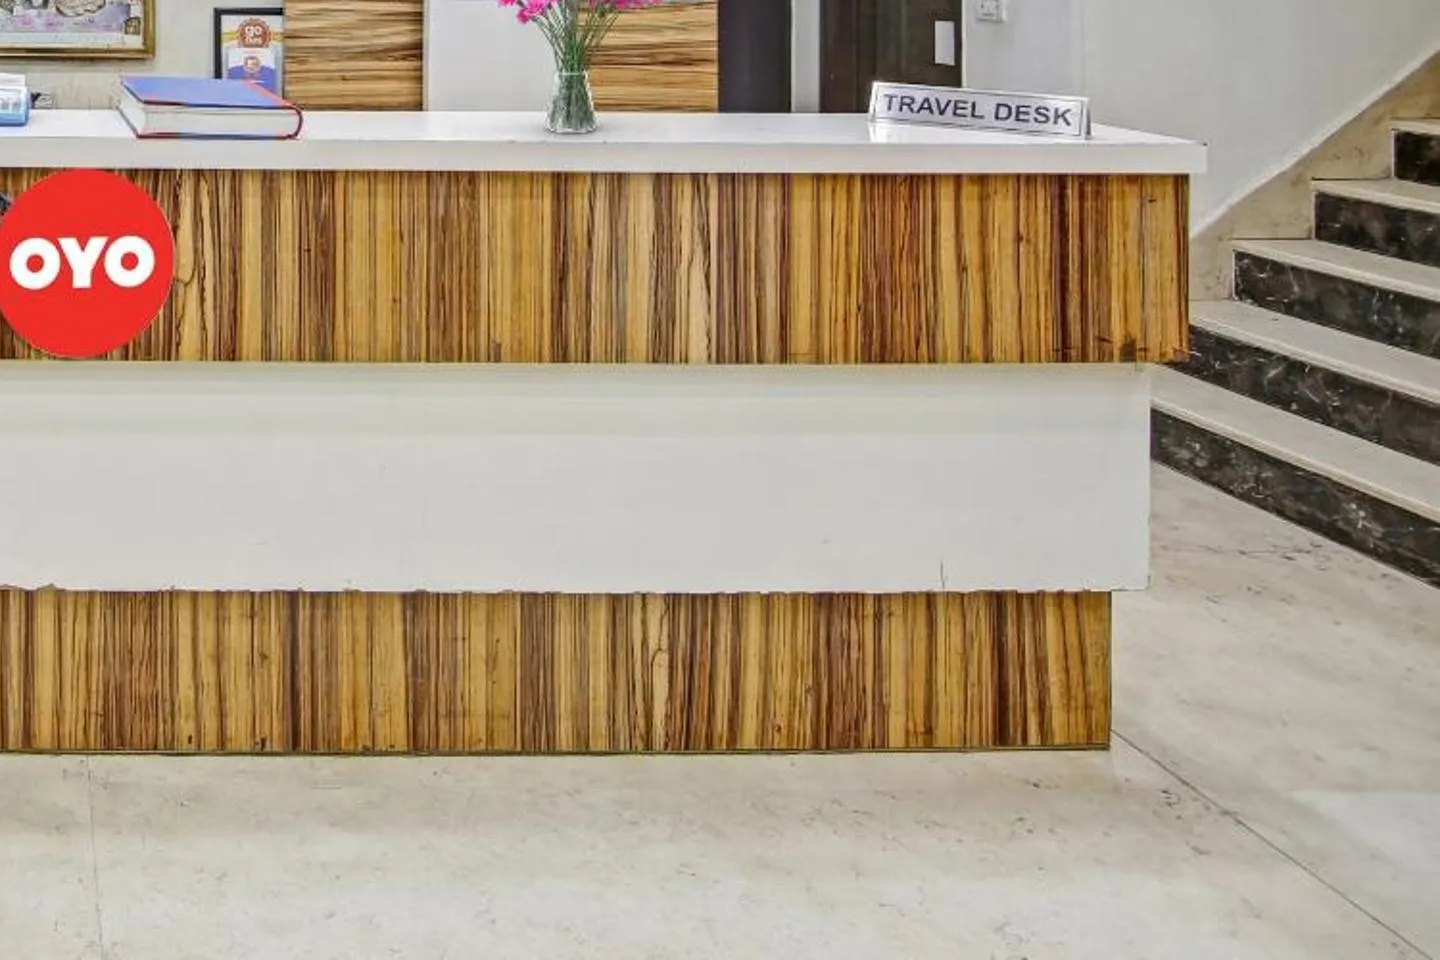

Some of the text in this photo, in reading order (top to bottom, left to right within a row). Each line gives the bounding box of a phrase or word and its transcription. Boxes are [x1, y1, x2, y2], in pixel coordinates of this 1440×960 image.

[883, 93, 1072, 127] TRAVEL DESK
[10, 235, 155, 289] OYO
